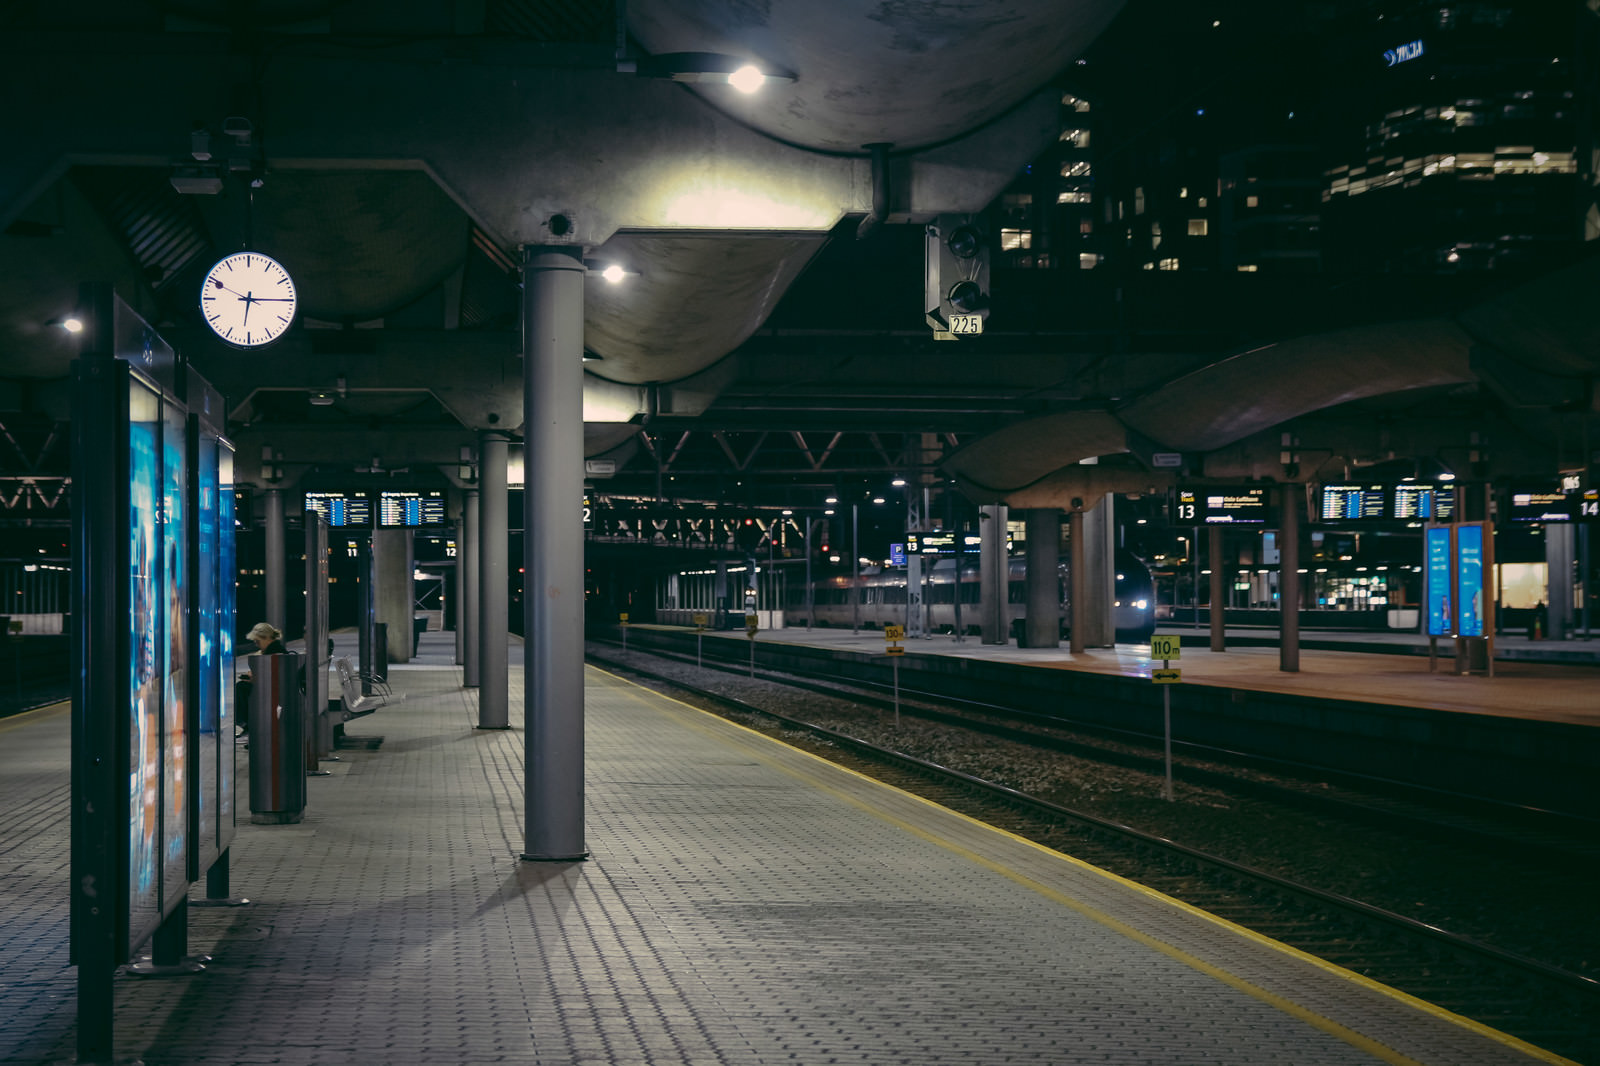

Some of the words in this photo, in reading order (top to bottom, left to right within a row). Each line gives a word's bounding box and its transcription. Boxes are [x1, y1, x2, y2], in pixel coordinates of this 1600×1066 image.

[953, 317, 978, 333] 225
[583, 507, 591, 522] 2
[1177, 504, 1195, 519] 13
[1580, 501, 1599, 516] 14
[347, 548, 358, 557] 11
[445, 547, 457, 557] 12
[907, 542, 918, 551] 13
